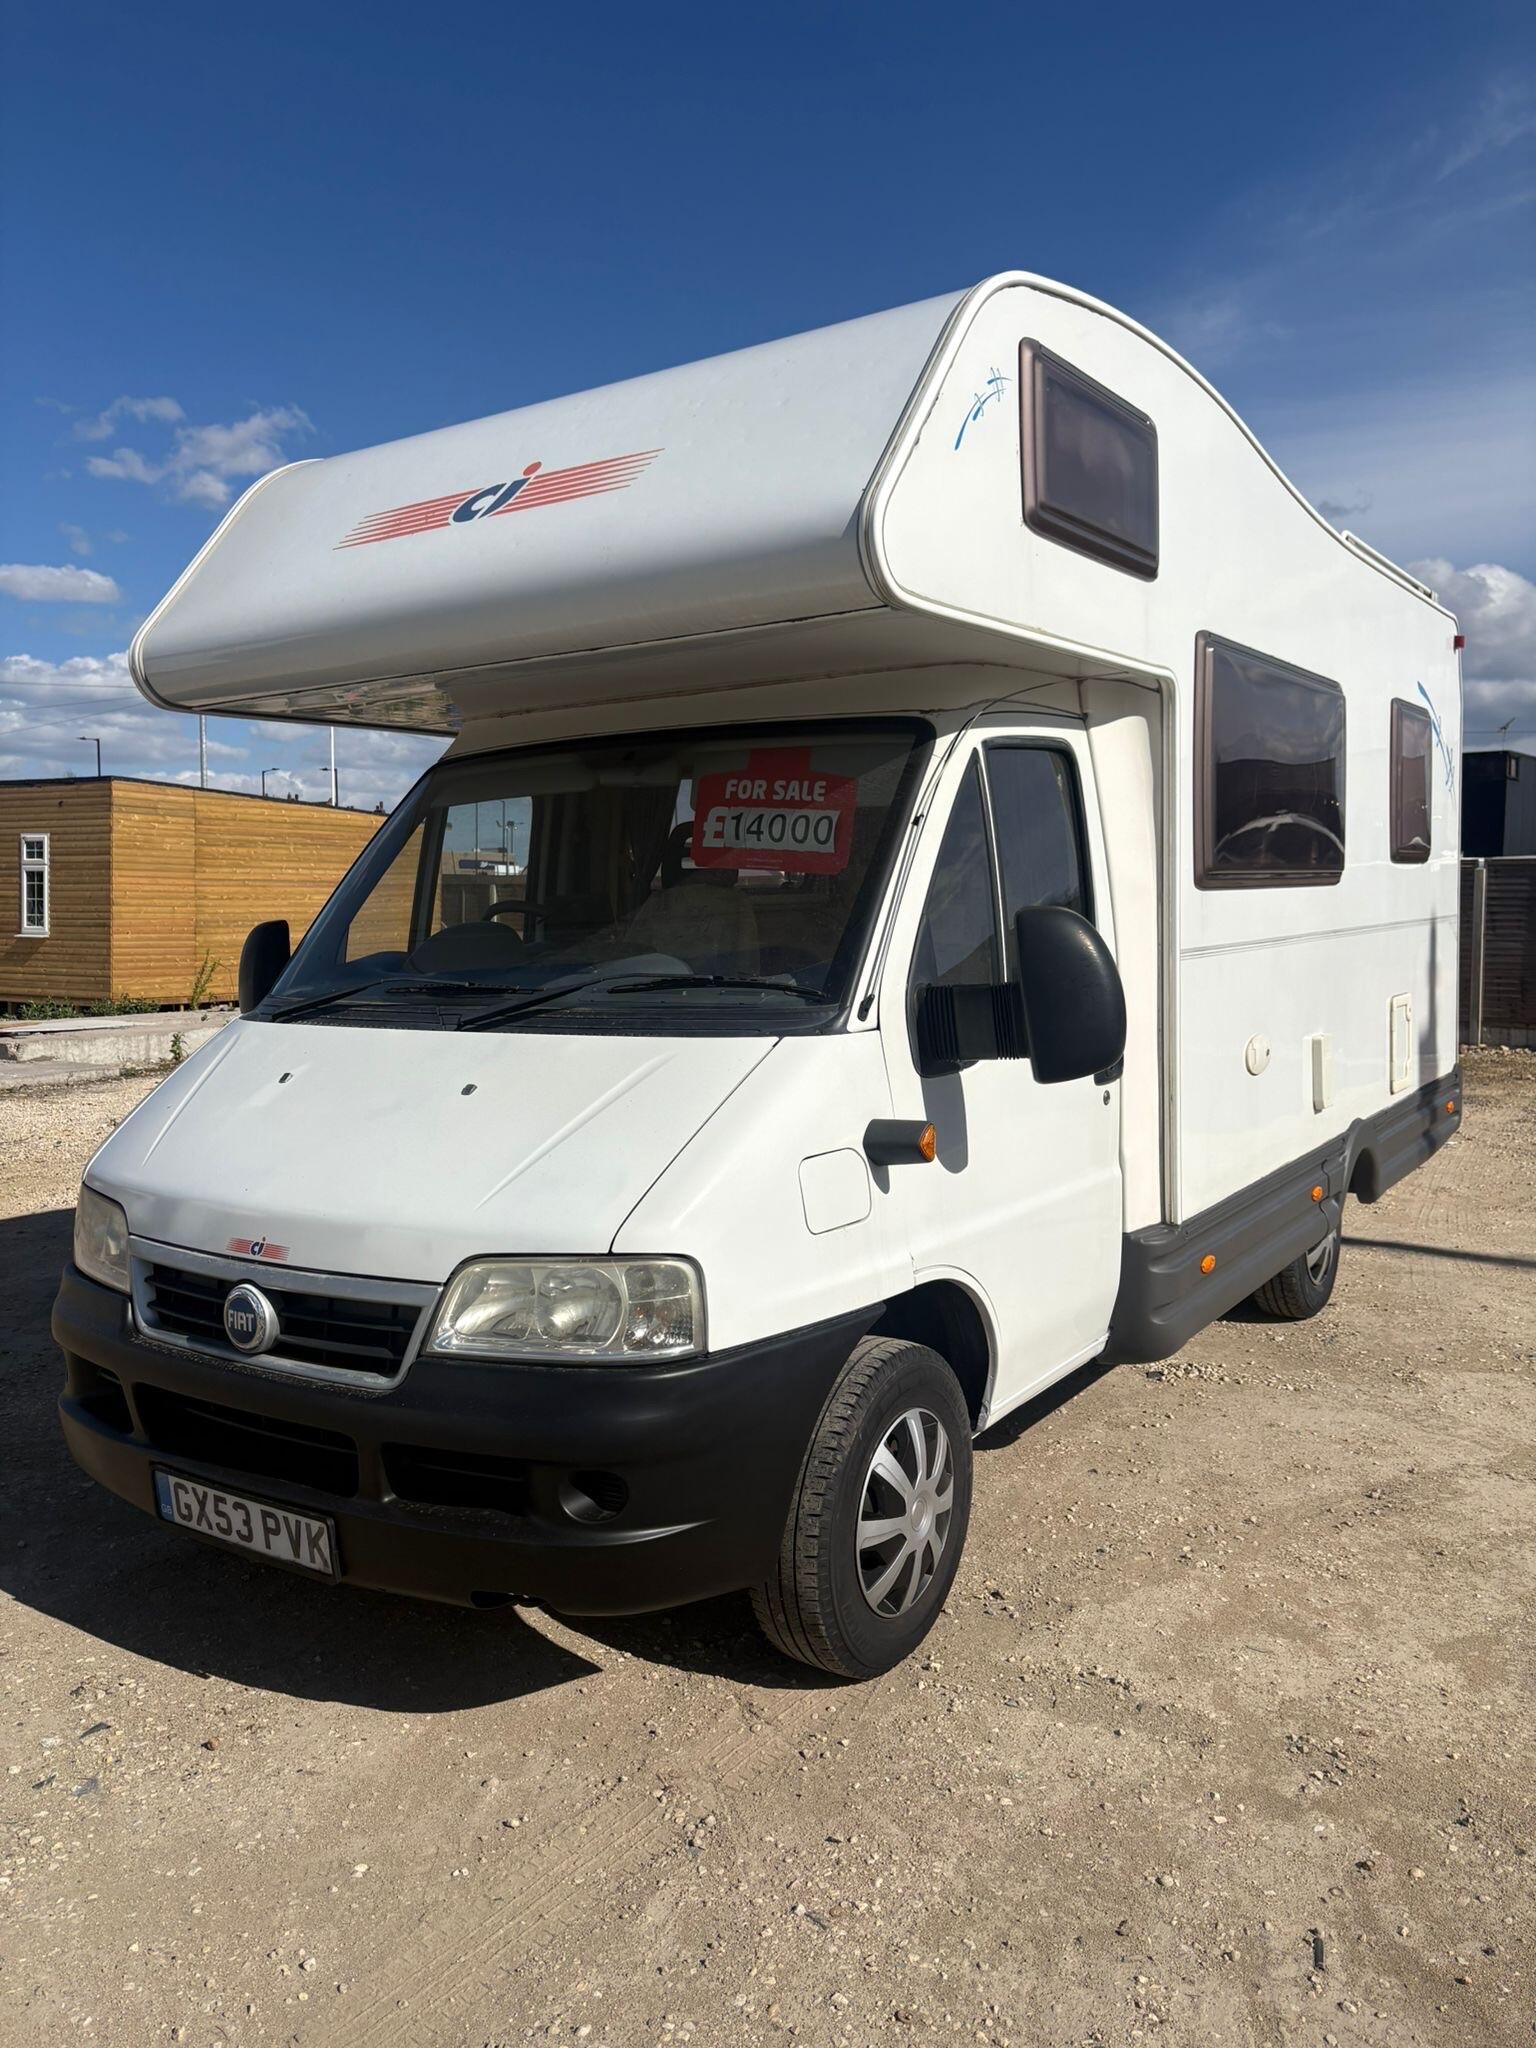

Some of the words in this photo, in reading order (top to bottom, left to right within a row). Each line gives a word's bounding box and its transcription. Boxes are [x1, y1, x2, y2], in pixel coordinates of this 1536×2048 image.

[725, 779, 767, 800] FOR
[773, 780, 826, 801] SALE
[702, 806, 834, 847] £14000
[228, 1310, 254, 1332] FIAT
[174, 1482, 254, 1543] GX53
[260, 1509, 330, 1569] PVK
